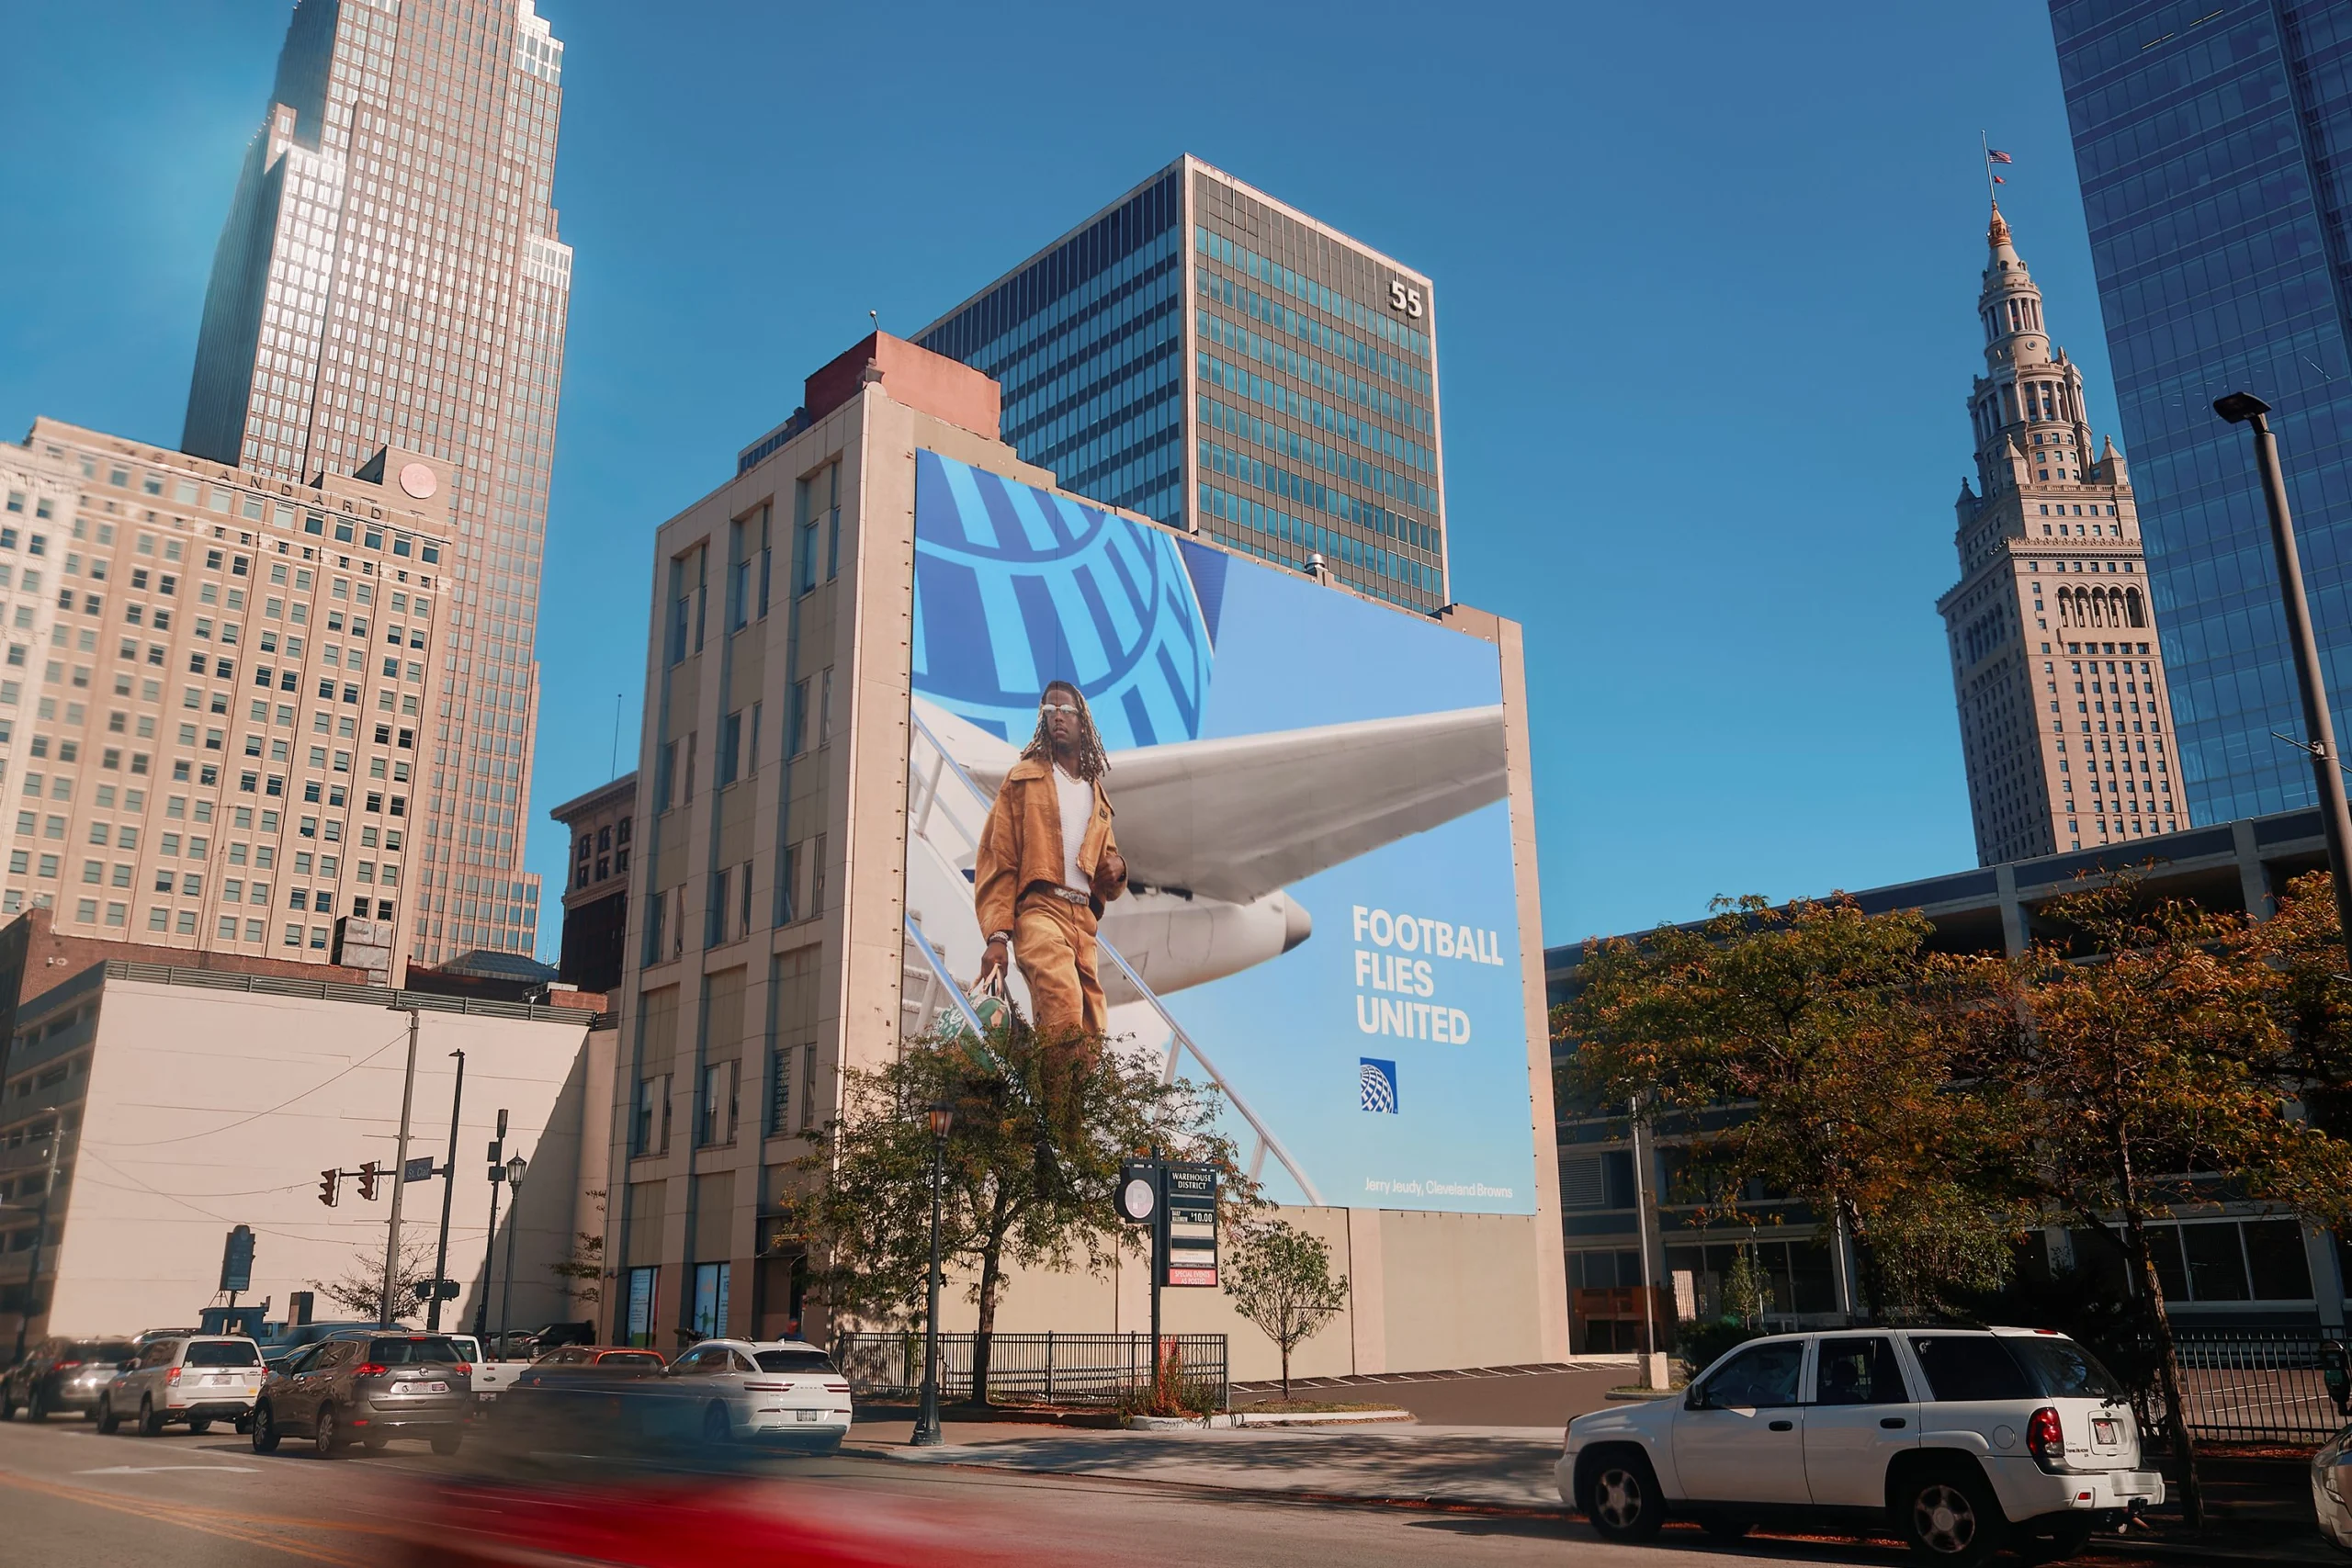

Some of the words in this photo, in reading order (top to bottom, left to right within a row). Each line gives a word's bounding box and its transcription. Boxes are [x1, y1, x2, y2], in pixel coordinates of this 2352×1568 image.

[1391, 279, 1422, 318] 55
[1352, 905, 1504, 966] FOOTBALL
[1355, 950, 1434, 998] FLIES
[1357, 995, 1471, 1045] UNITED
[1171, 1172, 1212, 1182] WAREHOUSE
[1177, 1181, 1206, 1190] DISTRICT
[1365, 1177, 1391, 1195] Jerry
[1392, 1179, 1424, 1197] Jeudy,
[1426, 1180, 1476, 1197] Cleveland
[1477, 1183, 1513, 1199] Browns
[1191, 1212, 1213, 1223] $10.00
